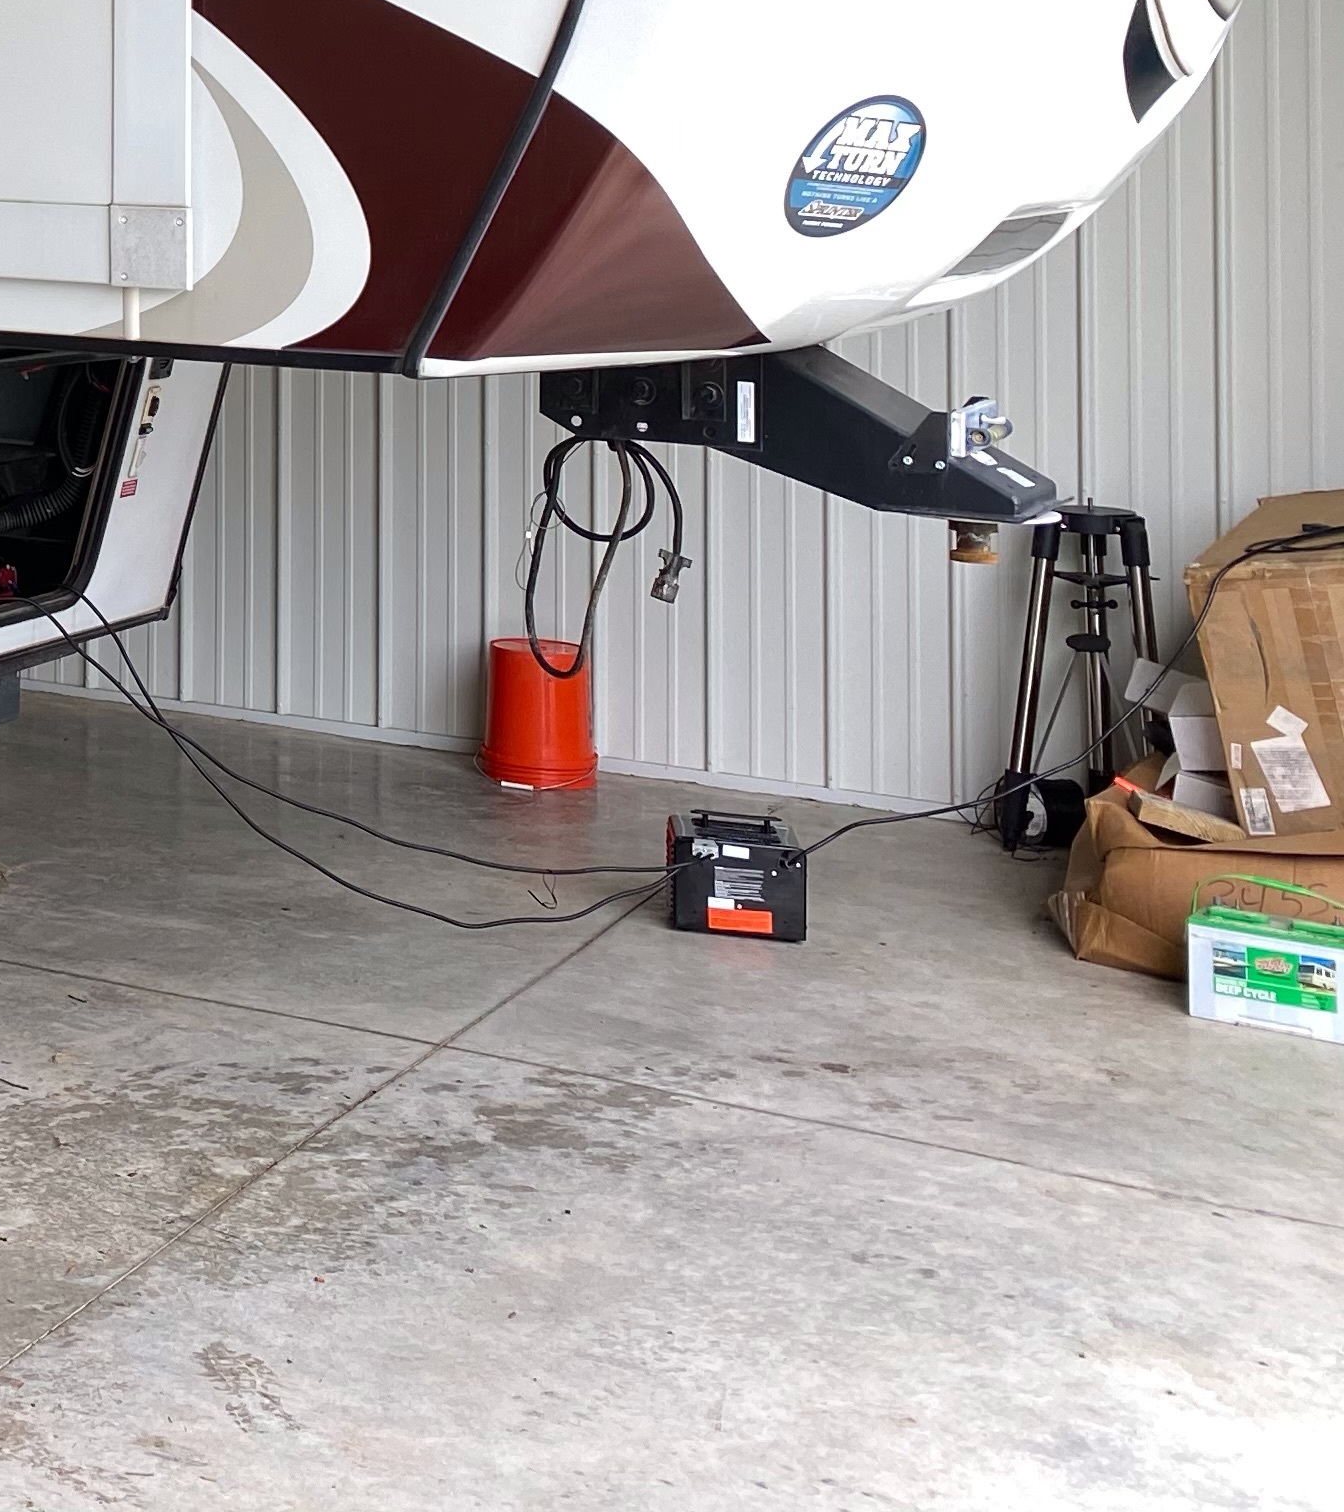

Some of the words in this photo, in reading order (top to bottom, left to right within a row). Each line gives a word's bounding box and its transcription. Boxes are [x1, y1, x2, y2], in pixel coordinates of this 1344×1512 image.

[836, 115, 922, 153] MAX
[827, 144, 908, 176] TURN
[812, 170, 891, 187] TECHNOLOGY
[1215, 983, 1242, 995] DEEP
[1243, 987, 1277, 1002] CYCLE
